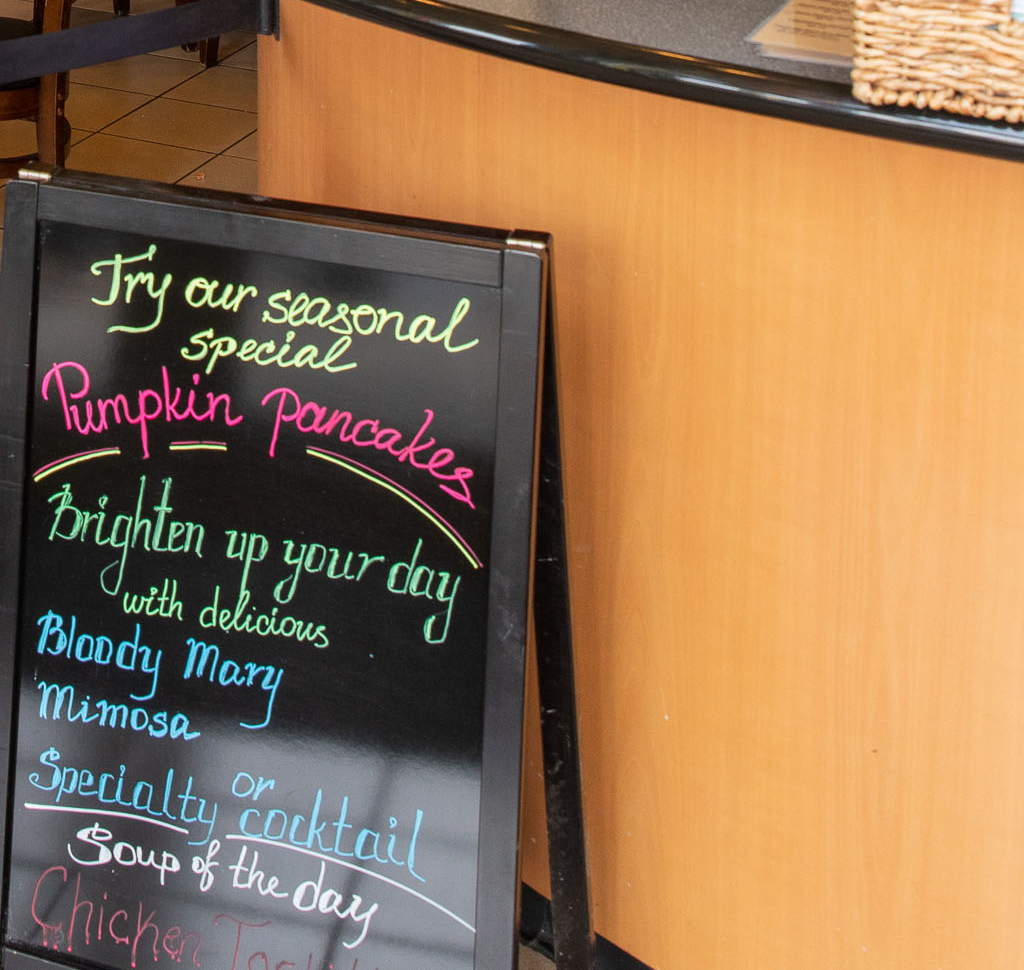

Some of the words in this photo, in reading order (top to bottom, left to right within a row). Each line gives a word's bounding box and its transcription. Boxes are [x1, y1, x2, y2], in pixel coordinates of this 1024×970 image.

[90, 245, 170, 333] Try
[185, 276, 257, 314] our
[261, 289, 479, 353] seasonal
[181, 327, 358, 374] special
[42, 361, 243, 459] Pumpkin
[47, 474, 205, 596] Brighten
[225, 528, 269, 594] up
[275, 538, 385, 604] your
[387, 538, 463, 644] day
[122, 579, 183, 620] with
[199, 586, 330, 649] delicious
[36, 609, 164, 701] Bloody
[182, 634, 284, 729] Mary
[36, 679, 201, 741] Mimosa
[28, 746, 219, 847] Specialty
[238, 788, 426, 883] cocktail
[231, 771, 276, 801] or
[30, 864, 202, 968] Chicken
[67, 822, 182, 887] Soup
[191, 838, 222, 892] of
[229, 850, 290, 898] the
[291, 861, 379, 949] day
